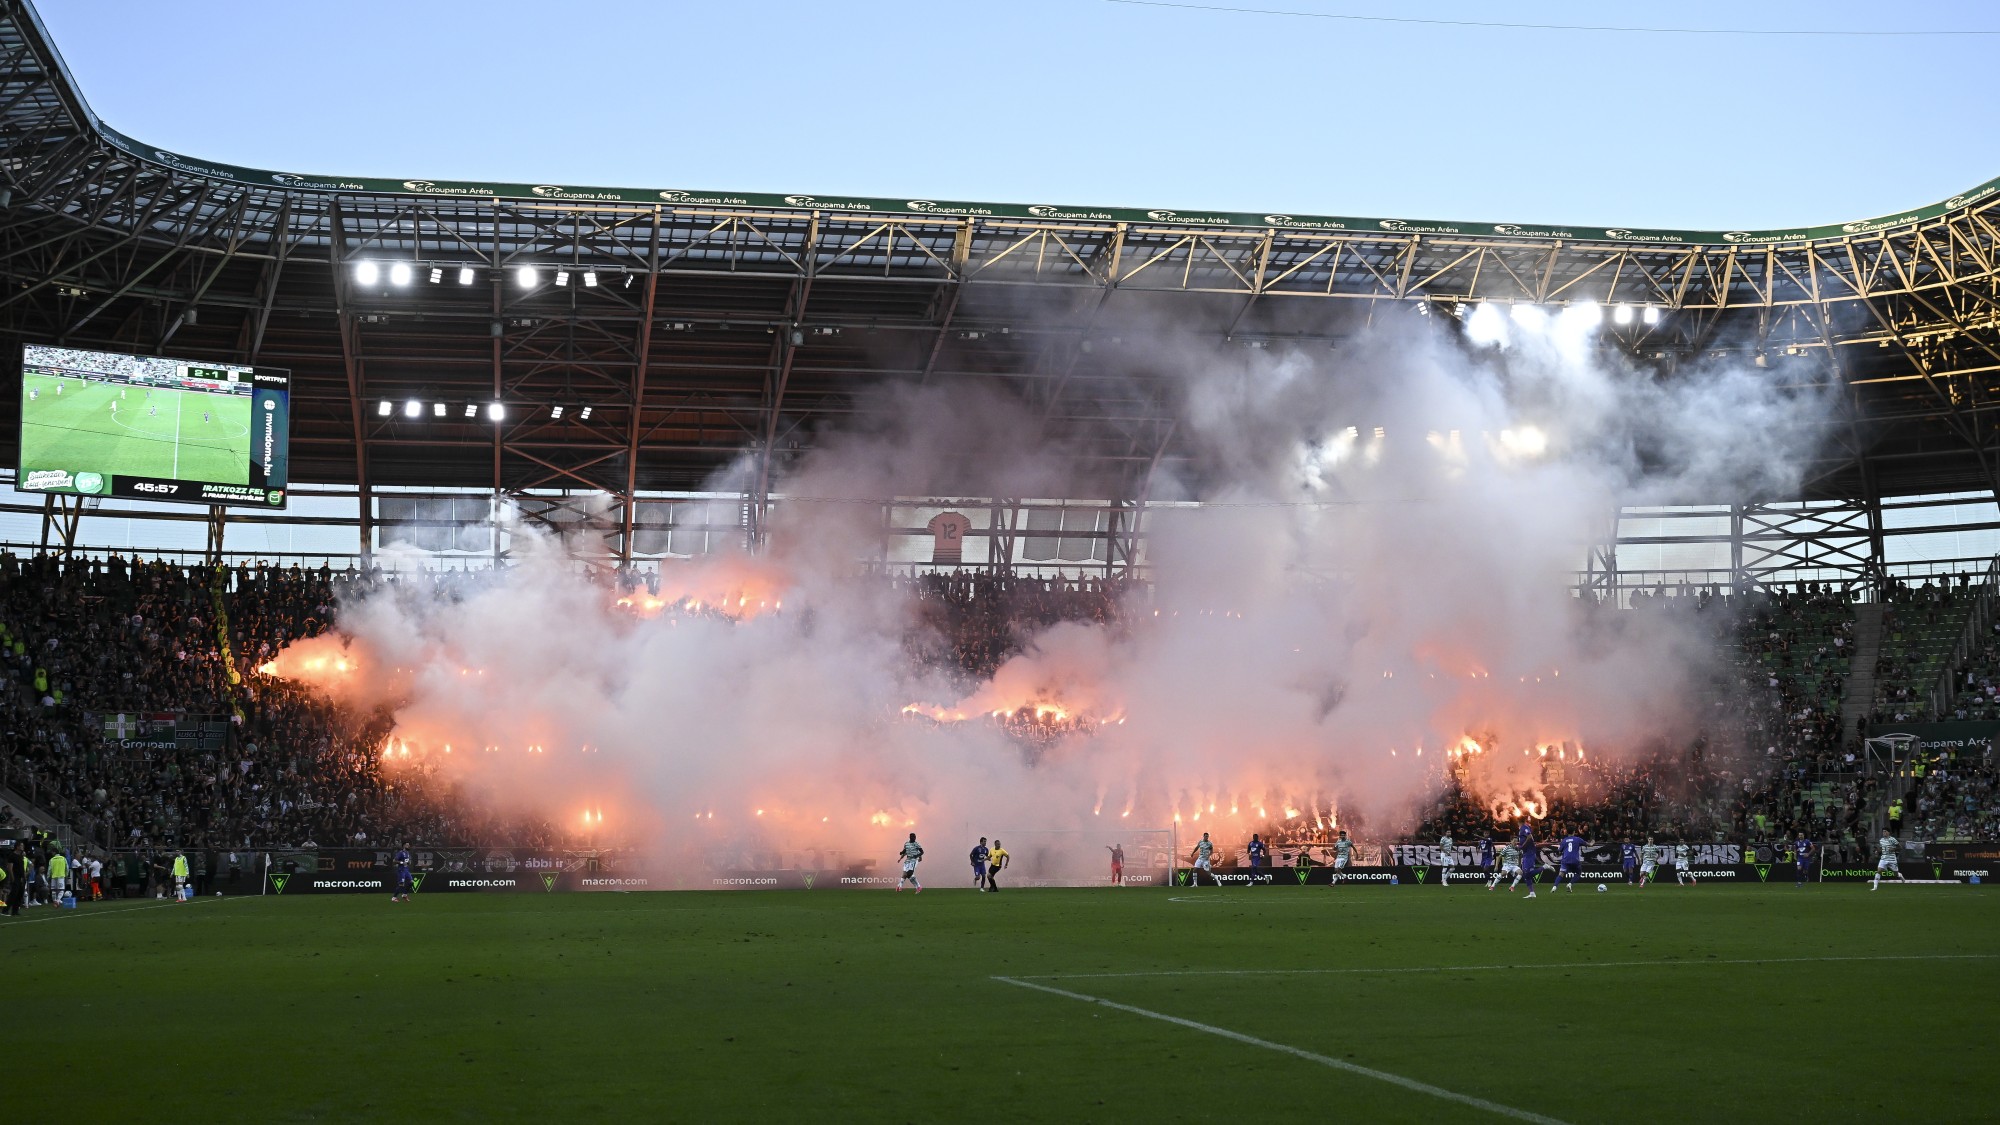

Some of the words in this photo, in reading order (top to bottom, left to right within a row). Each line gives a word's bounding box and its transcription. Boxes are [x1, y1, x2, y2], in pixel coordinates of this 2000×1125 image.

[171, 159, 209, 174] Groupama
[210, 168, 234, 179] Aréna
[293, 180, 336, 189] Groupama
[338, 182, 364, 190] Aréna
[424, 185, 467, 194] Groupama
[468, 187, 494, 195] Aréna
[553, 190, 595, 199] Groupama
[596, 192, 621, 200] Aréna
[680, 195, 721, 204] Groupama
[723, 197, 747, 205] Aréna
[805, 200, 845, 209] Groupama
[847, 202, 871, 210] Aréna
[927, 205, 967, 214] Groupama
[968, 207, 992, 215] Aréna
[1048, 210, 1087, 219] Groupama
[1167, 216, 1206, 224] Groupama
[1283, 219, 1322, 228] Groupama
[1323, 221, 1345, 229] Aréna
[1861, 222, 1898, 232] Groupama
[1898, 215, 1919, 225] Aréna
[1398, 225, 1435, 233] Groupama
[1624, 233, 1660, 241] Groupama
[254, 374, 287, 384] SPORTFIVE
[263, 413, 274, 477] mvmdome.hu
[133, 483, 179, 494] 45:57
[202, 484, 248, 494] IRATKOZZ
[248, 487, 265, 495] FEL
[942, 523, 957, 539] 12
[1567, 842, 1573, 853] 8
[1821, 868, 1843, 877] Own
[313, 880, 382, 888] macron.com
[449, 879, 516, 887] macron.com
[582, 878, 648, 886] macron.com
[712, 877, 777, 885] macron.com
